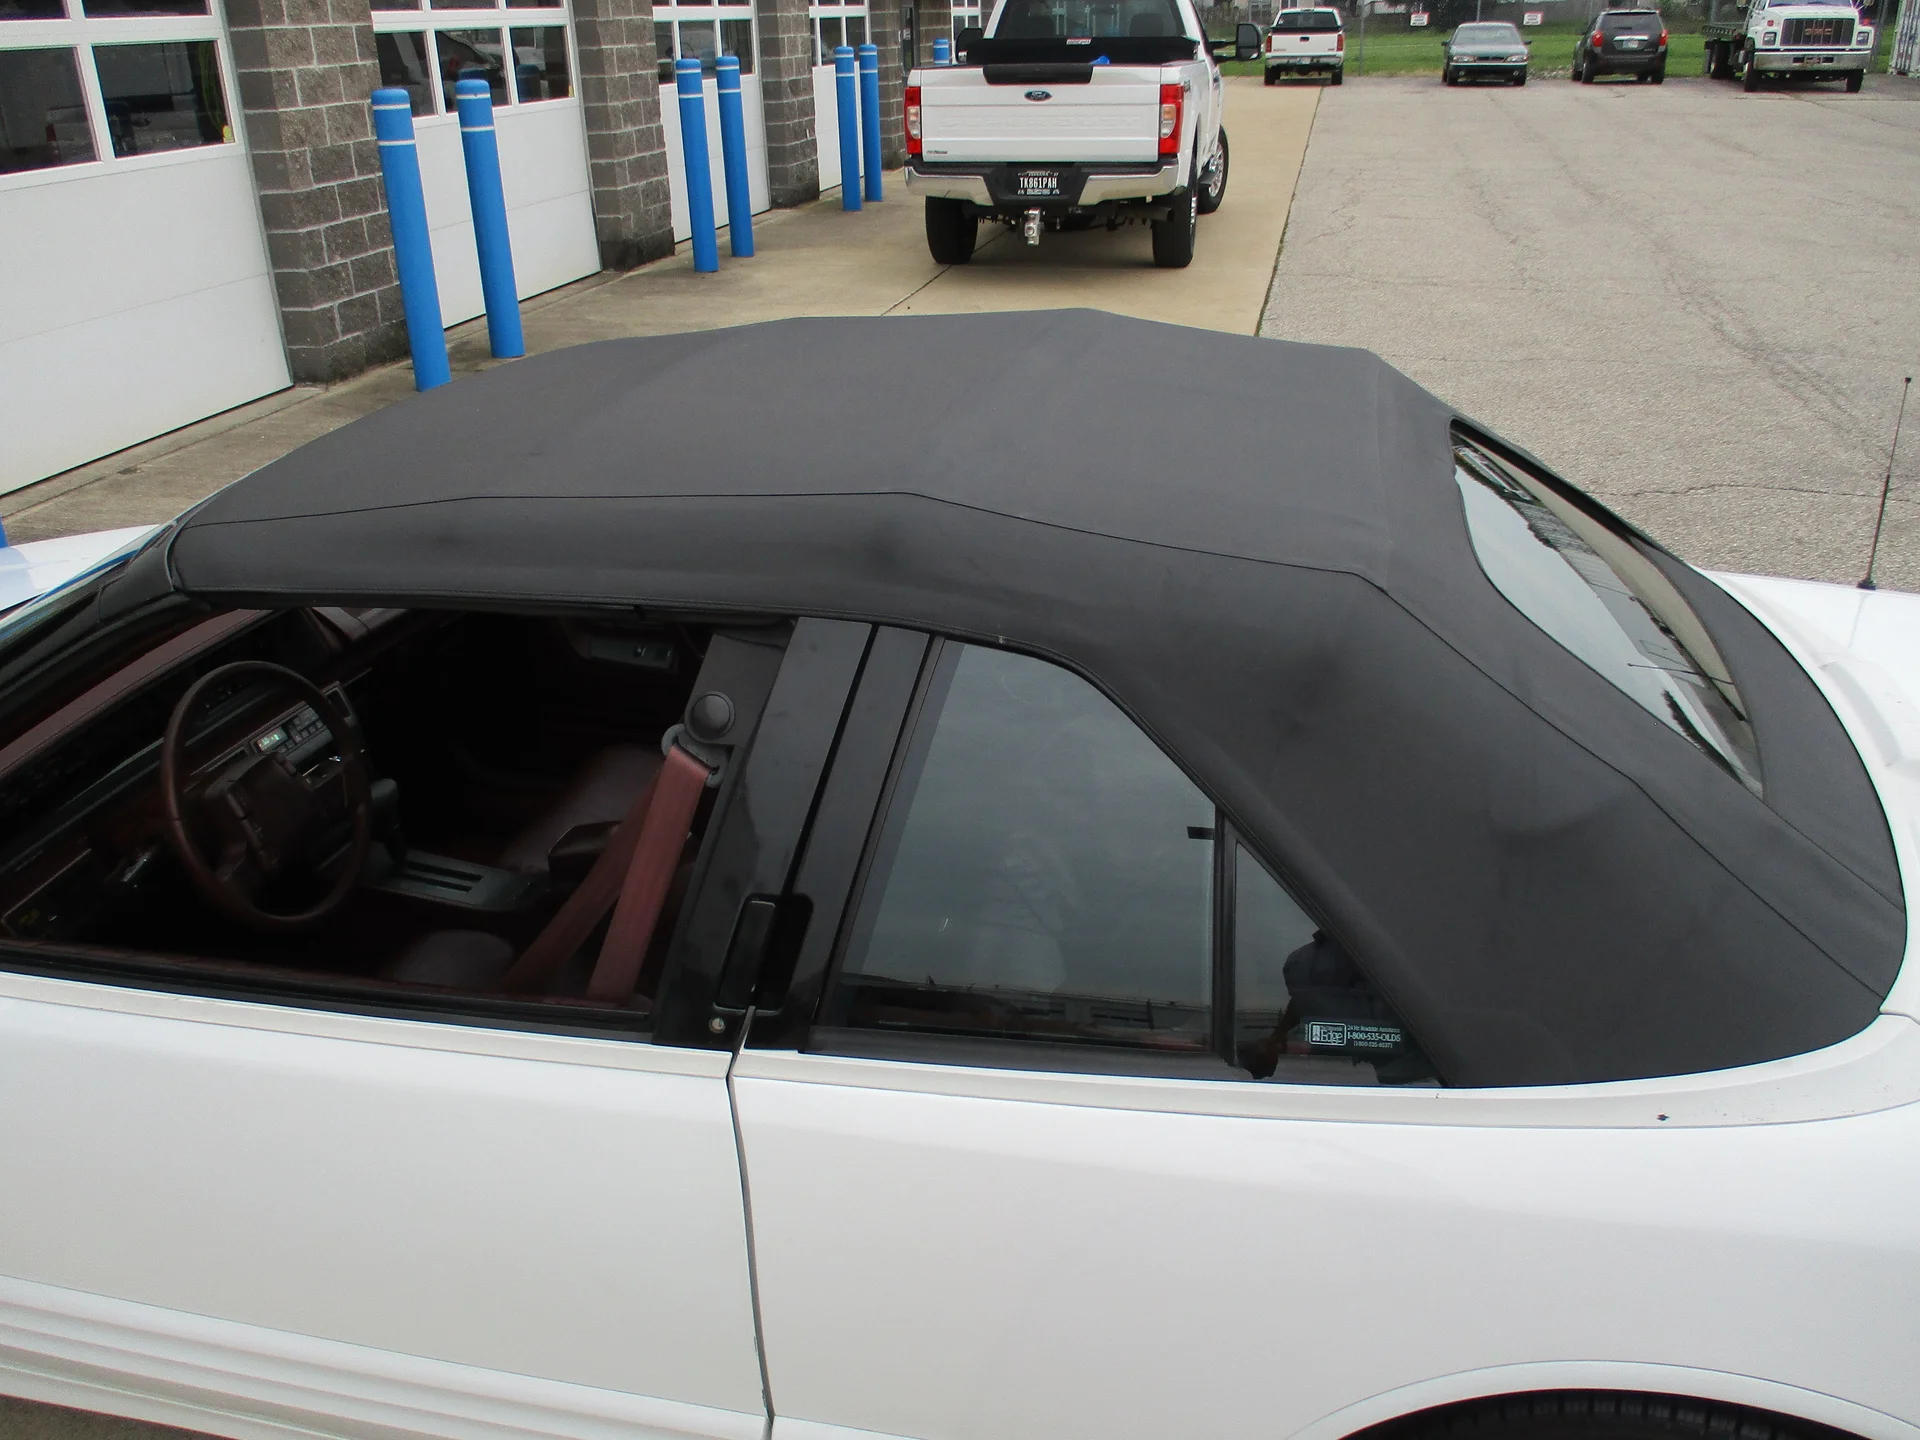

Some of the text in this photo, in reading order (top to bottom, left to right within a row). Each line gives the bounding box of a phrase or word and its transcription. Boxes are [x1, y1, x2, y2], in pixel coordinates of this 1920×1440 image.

[1804, 28, 1832, 36] GMC
[1321, 1029, 1343, 1044] Edge
[1347, 1031, 1401, 1042] 1-800-535-OLDS
